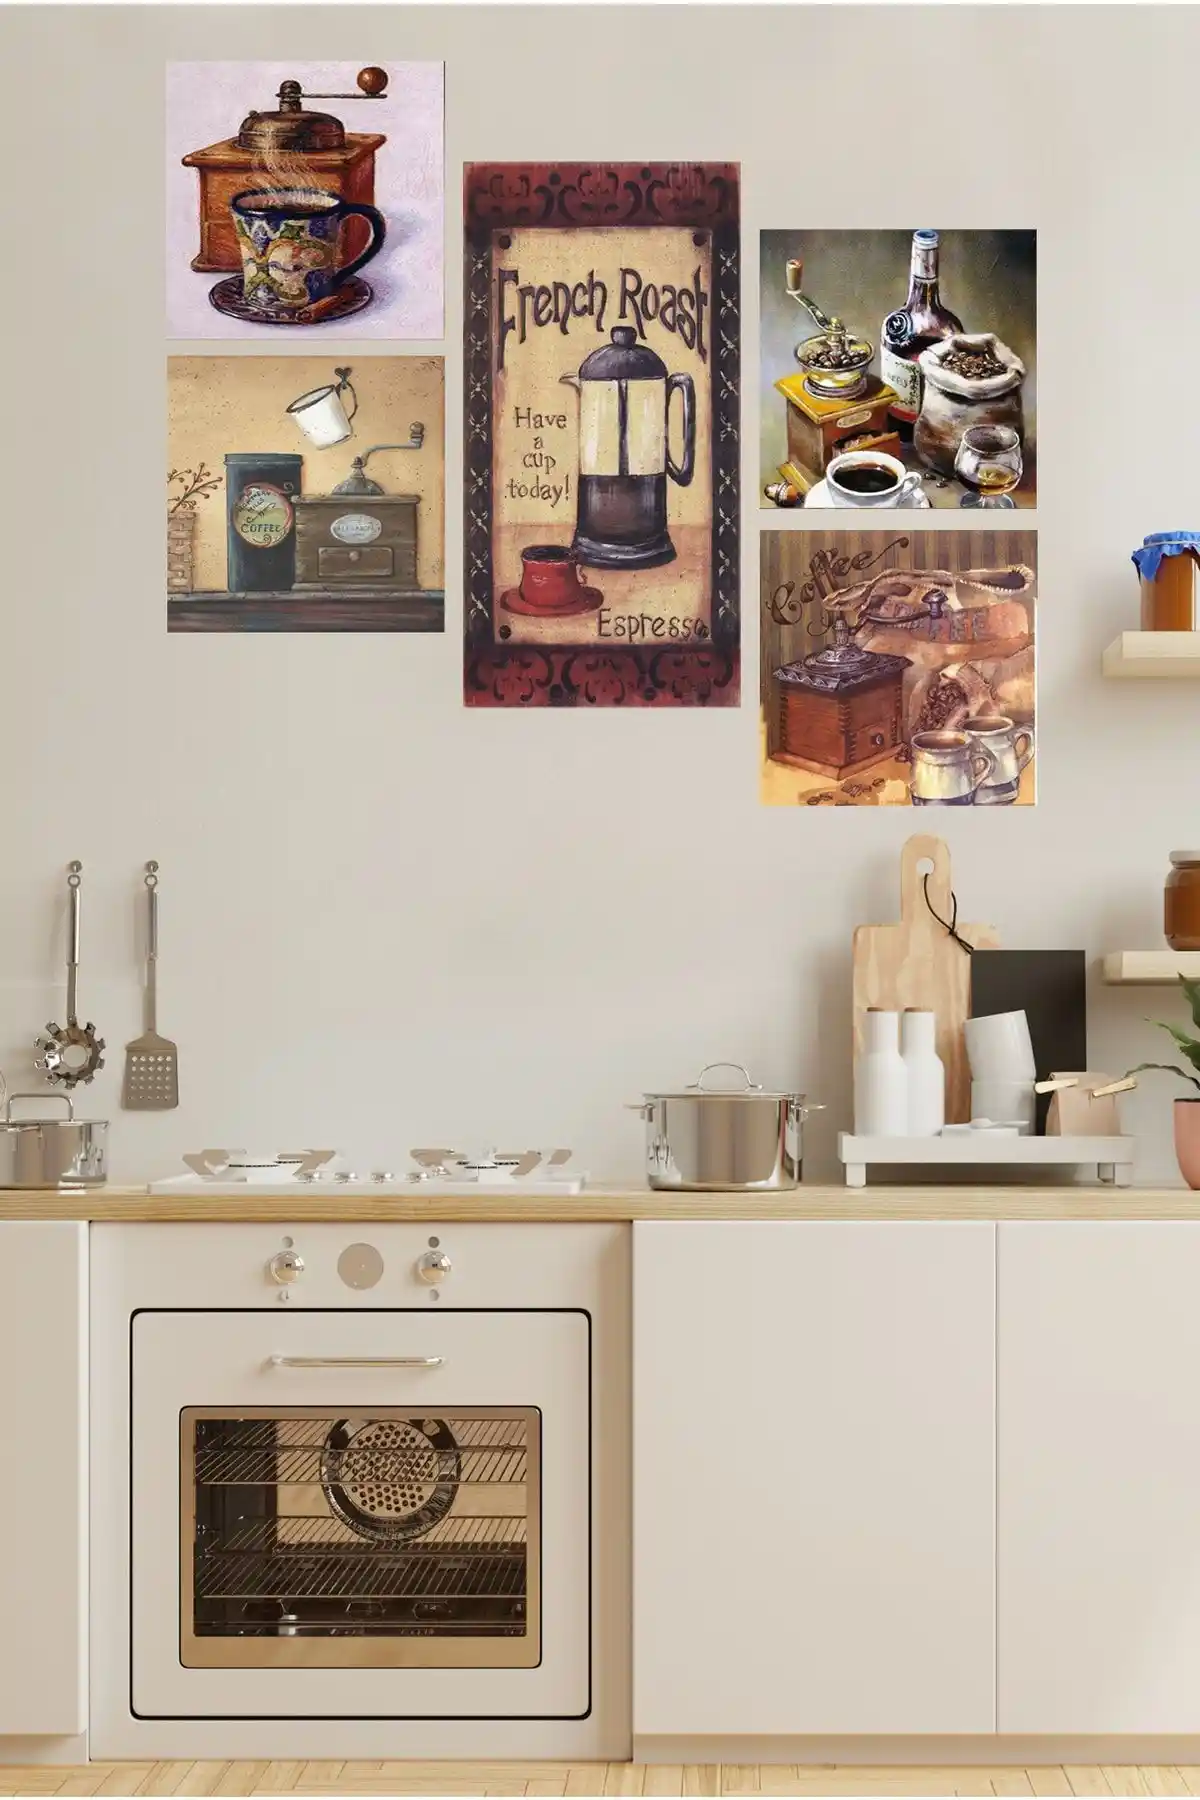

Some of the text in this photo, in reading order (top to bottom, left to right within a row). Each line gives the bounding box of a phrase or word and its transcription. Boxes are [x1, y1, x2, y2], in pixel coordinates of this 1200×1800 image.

[499, 265, 708, 371] French Roast
[514, 406, 568, 429] Have
[533, 436, 545, 450] a
[522, 452, 557, 475] cup
[506, 474, 570, 508] today!
[240, 523, 282, 533] COFFEE
[765, 536, 910, 636] Coffee
[598, 608, 709, 643] Espresso
